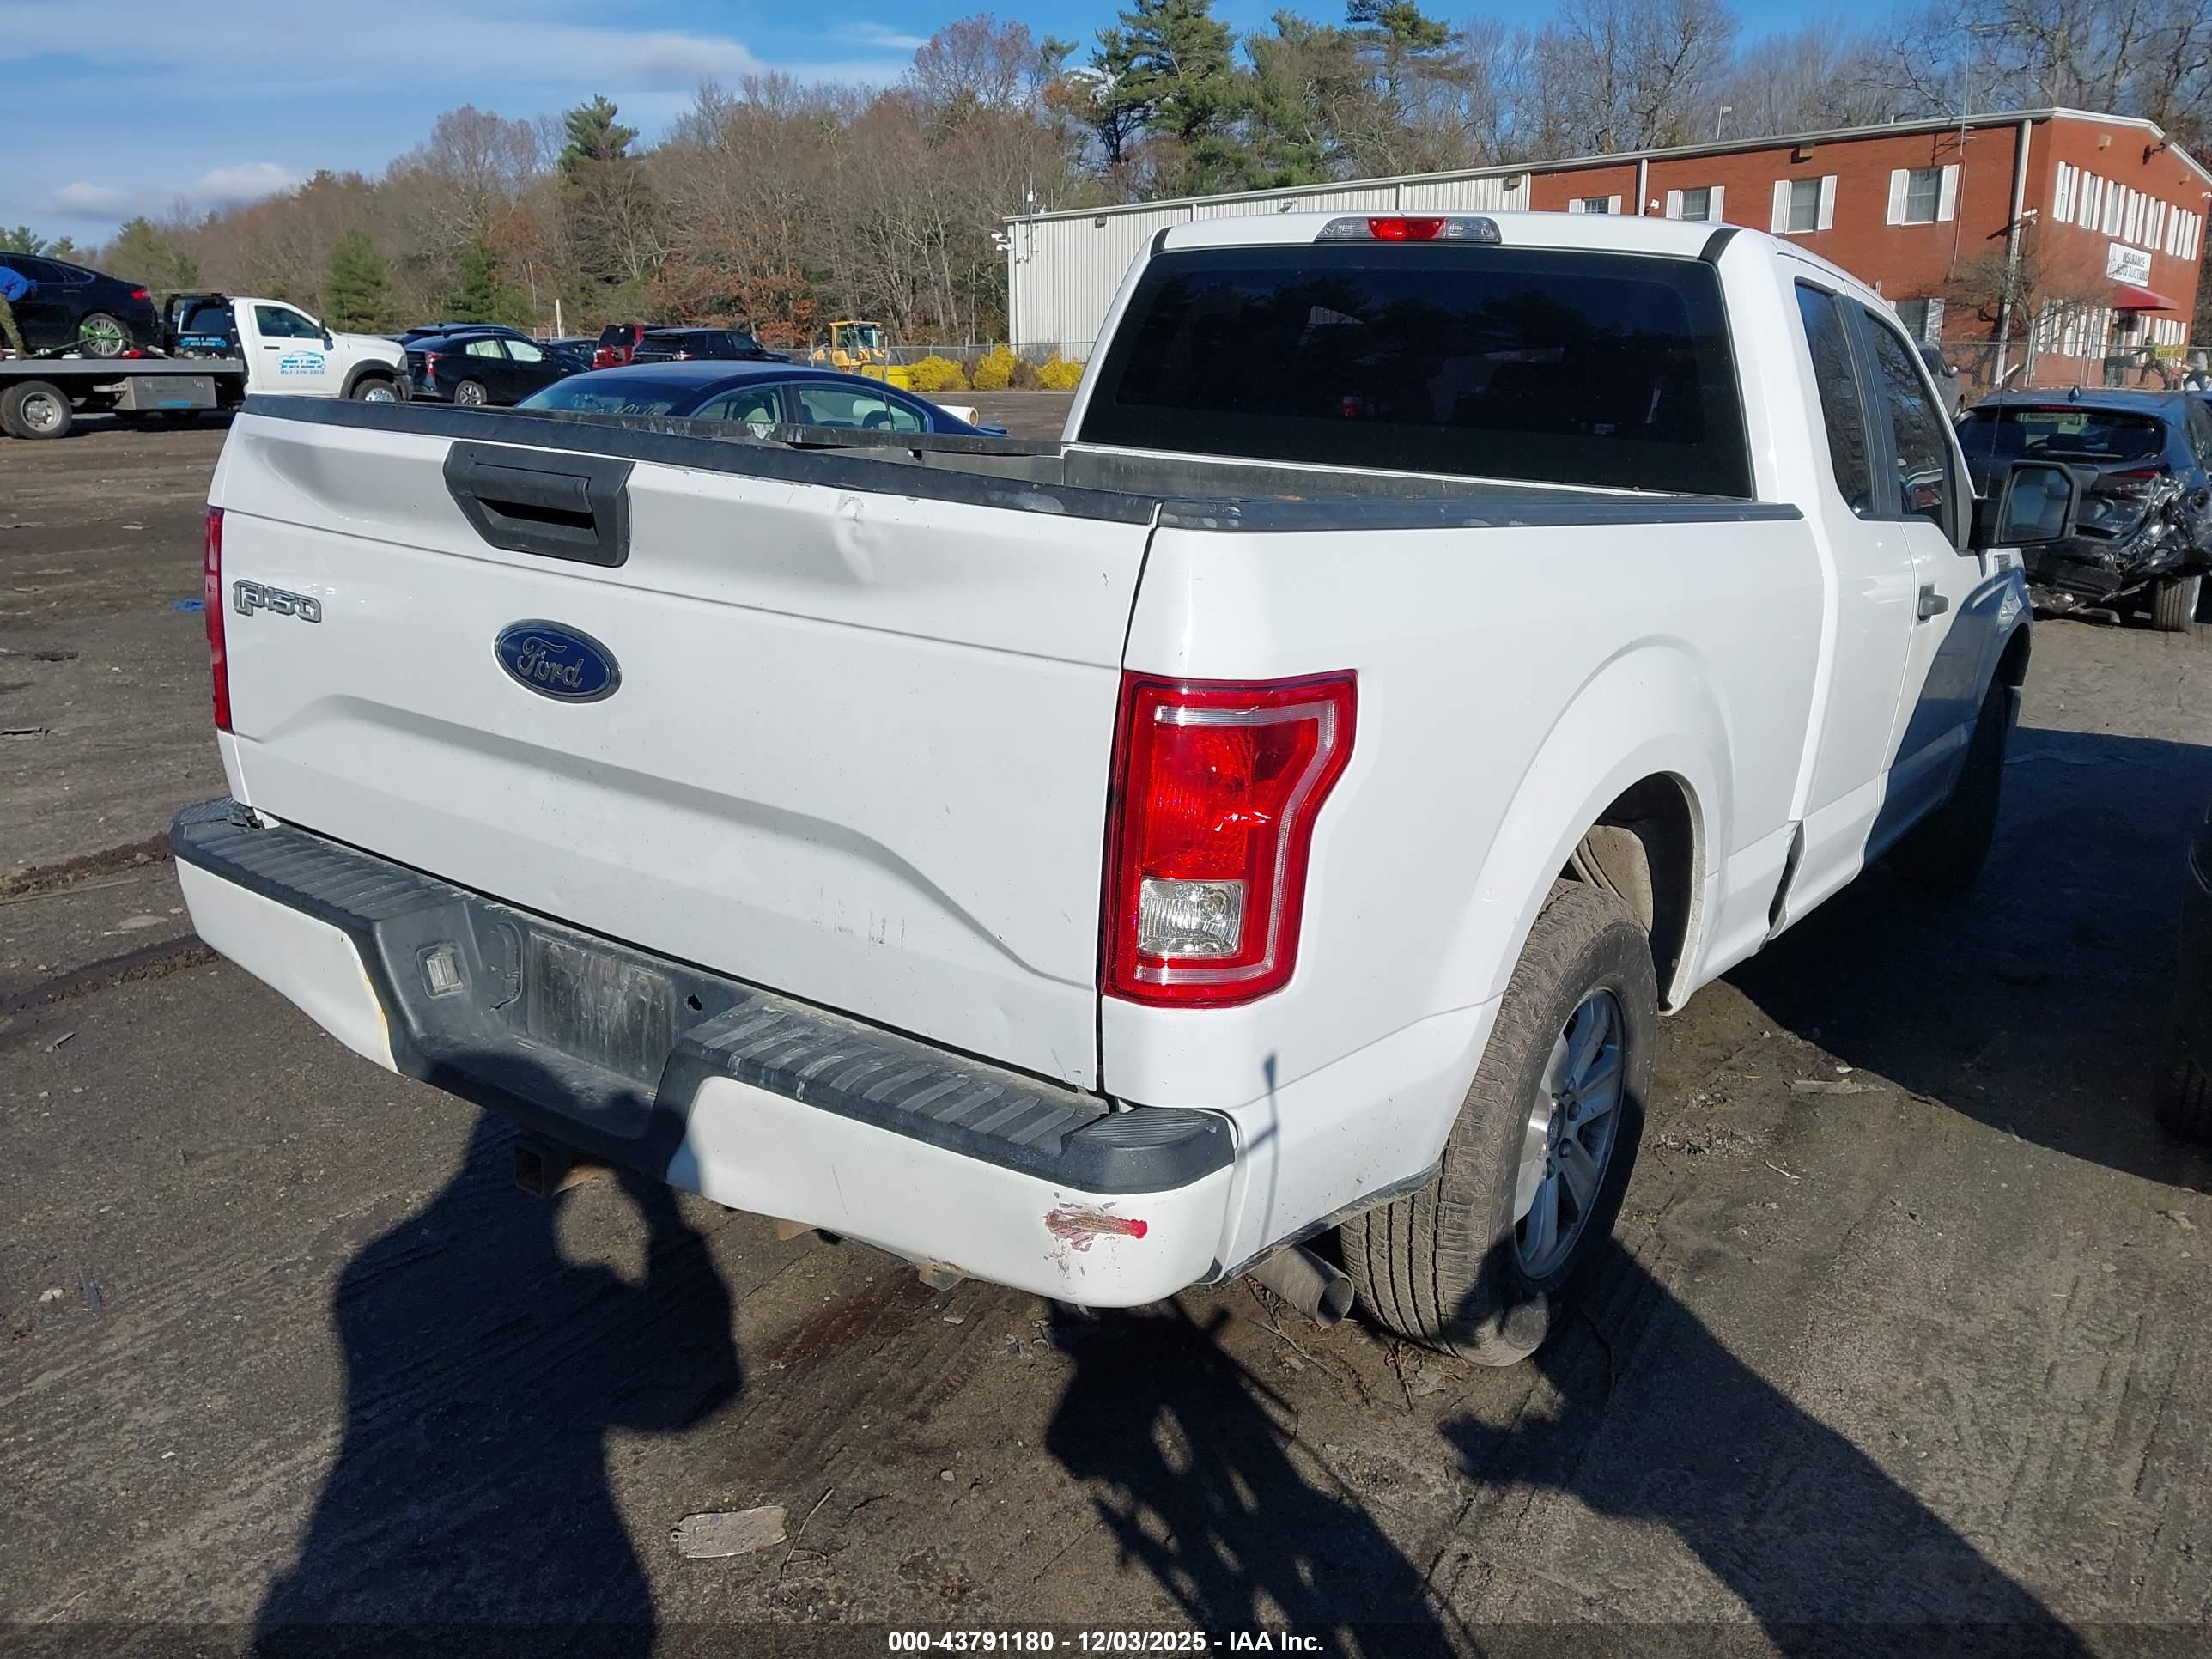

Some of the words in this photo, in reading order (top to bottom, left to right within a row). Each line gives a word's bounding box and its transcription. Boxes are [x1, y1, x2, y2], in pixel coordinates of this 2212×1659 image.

[2121, 252, 2146, 267] INSURANCE
[2129, 265, 2148, 282] AUCTIONS
[516, 635, 585, 688] Ford
